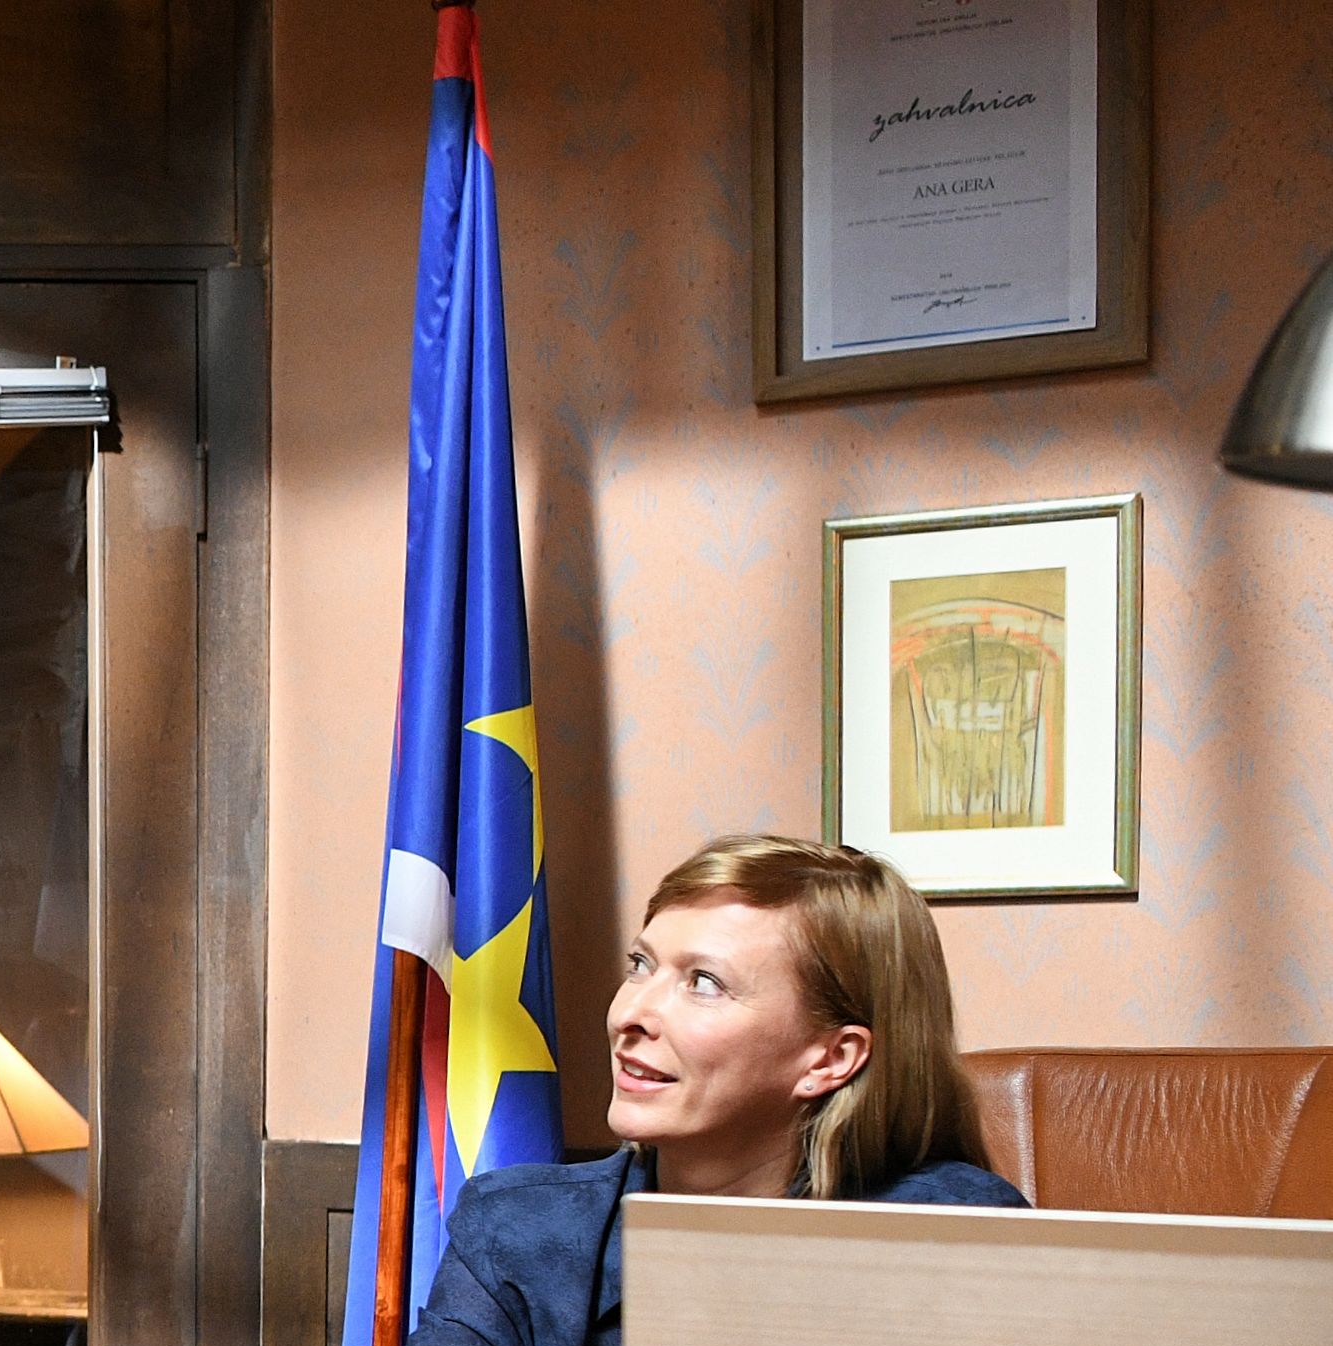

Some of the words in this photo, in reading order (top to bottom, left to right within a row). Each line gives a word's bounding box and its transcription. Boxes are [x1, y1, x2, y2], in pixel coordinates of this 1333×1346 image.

[869, 88, 1036, 142] zahvalnica
[912, 181, 948, 201] ANA
[951, 177, 995, 196] GERA
